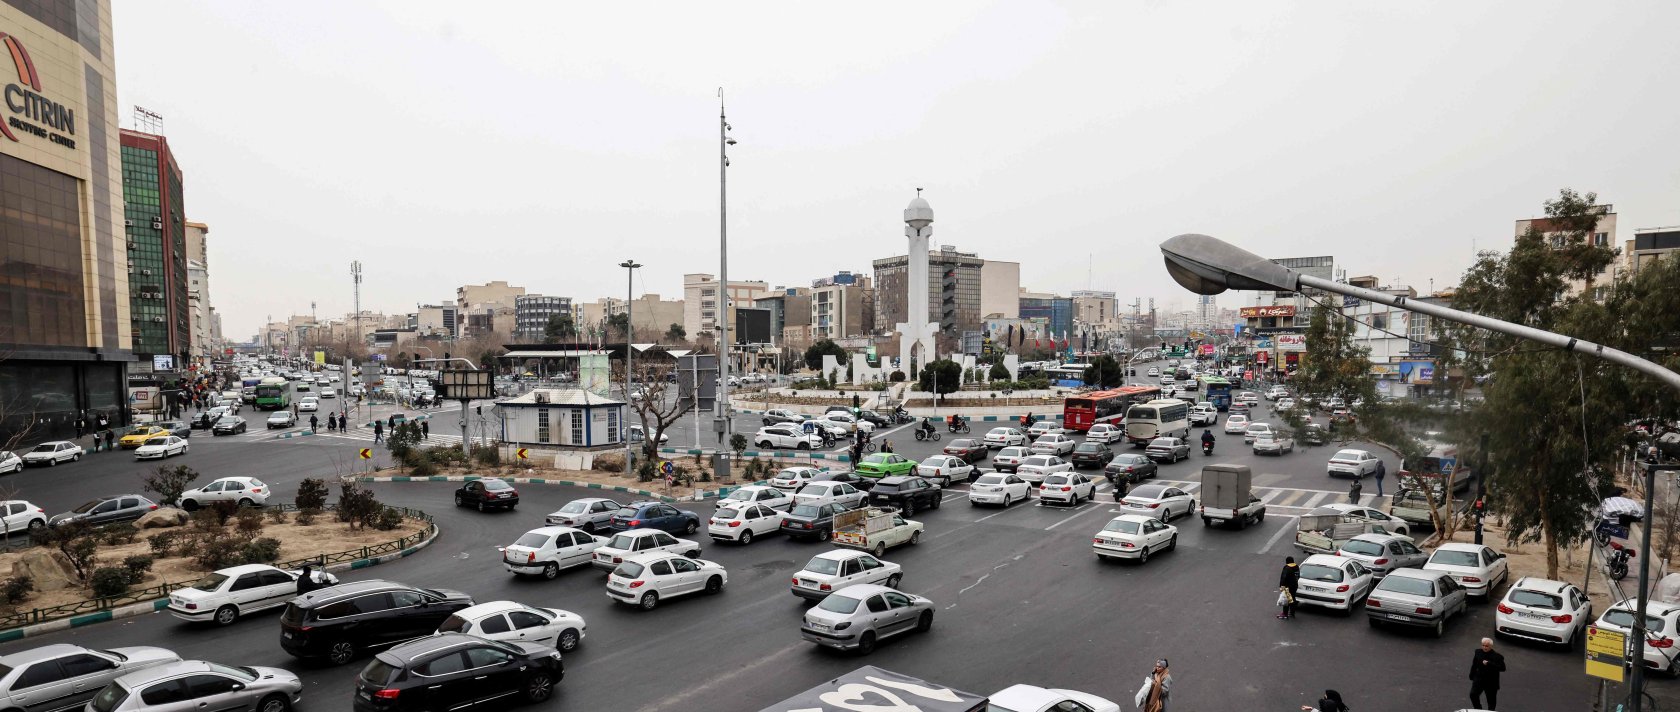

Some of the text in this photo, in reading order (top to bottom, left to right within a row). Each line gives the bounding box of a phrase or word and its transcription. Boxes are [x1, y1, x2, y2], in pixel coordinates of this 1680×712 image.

[5, 83, 75, 135] CITRIN
[9, 116, 76, 149] SHOPPING CENTER
